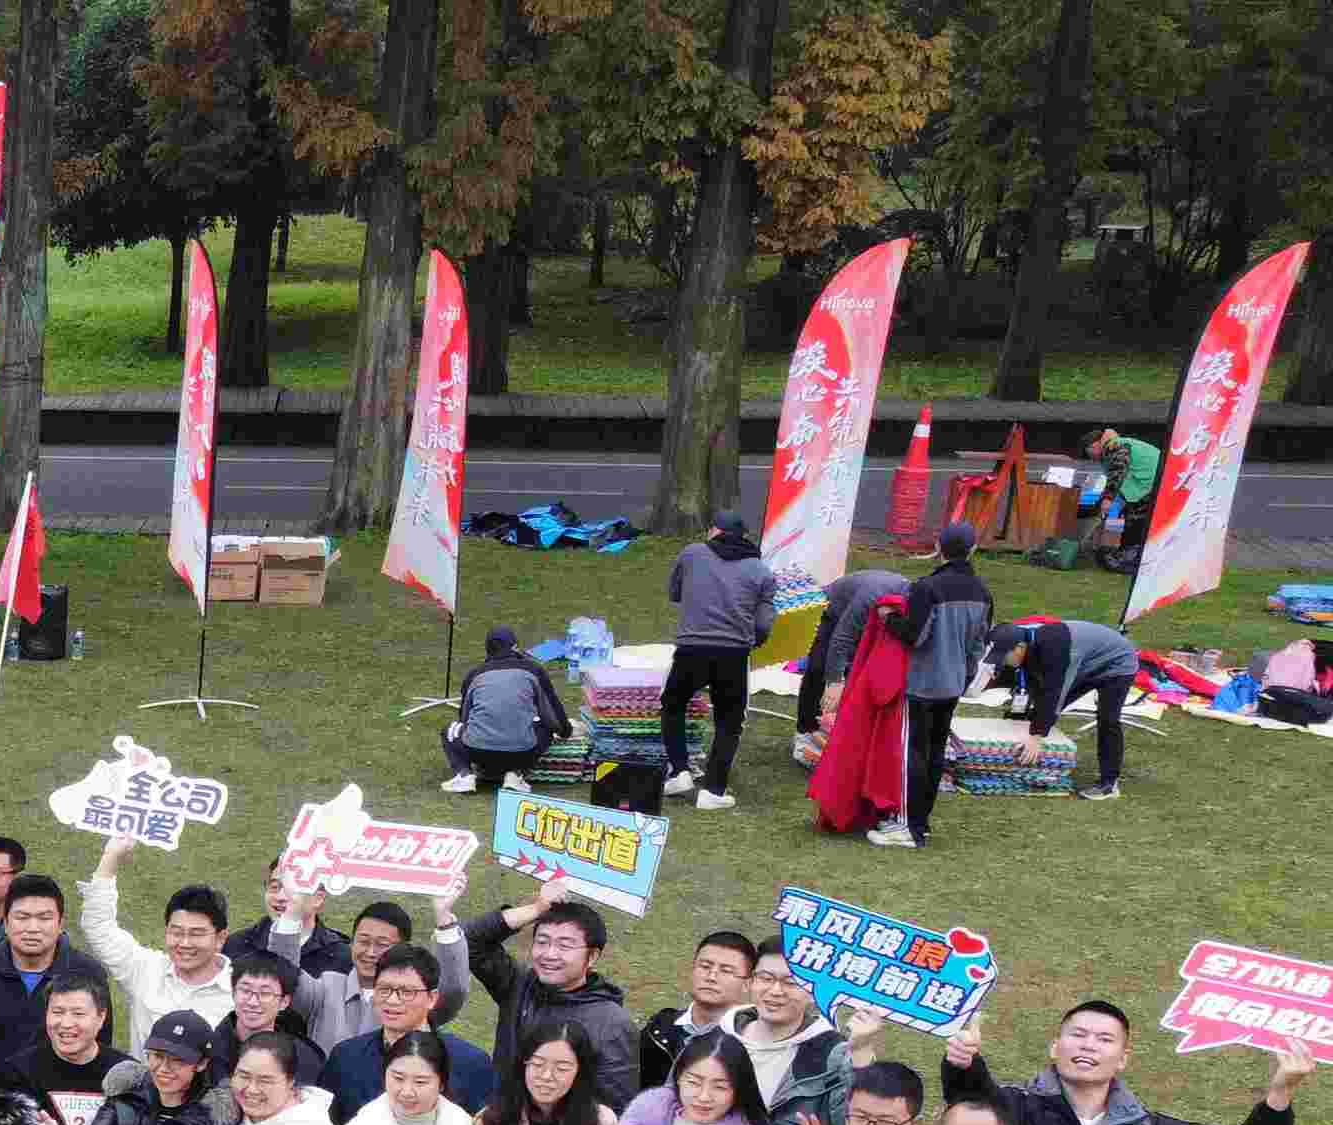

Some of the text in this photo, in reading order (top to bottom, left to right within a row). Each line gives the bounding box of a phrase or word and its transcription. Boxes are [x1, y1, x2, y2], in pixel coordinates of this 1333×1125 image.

[83, 796, 181, 843] 最可爱
[128, 770, 222, 817] 全公司
[516, 799, 641, 873] C位出道
[772, 895, 953, 971] 乘风破浪
[789, 937, 966, 1016] 拼搏前进
